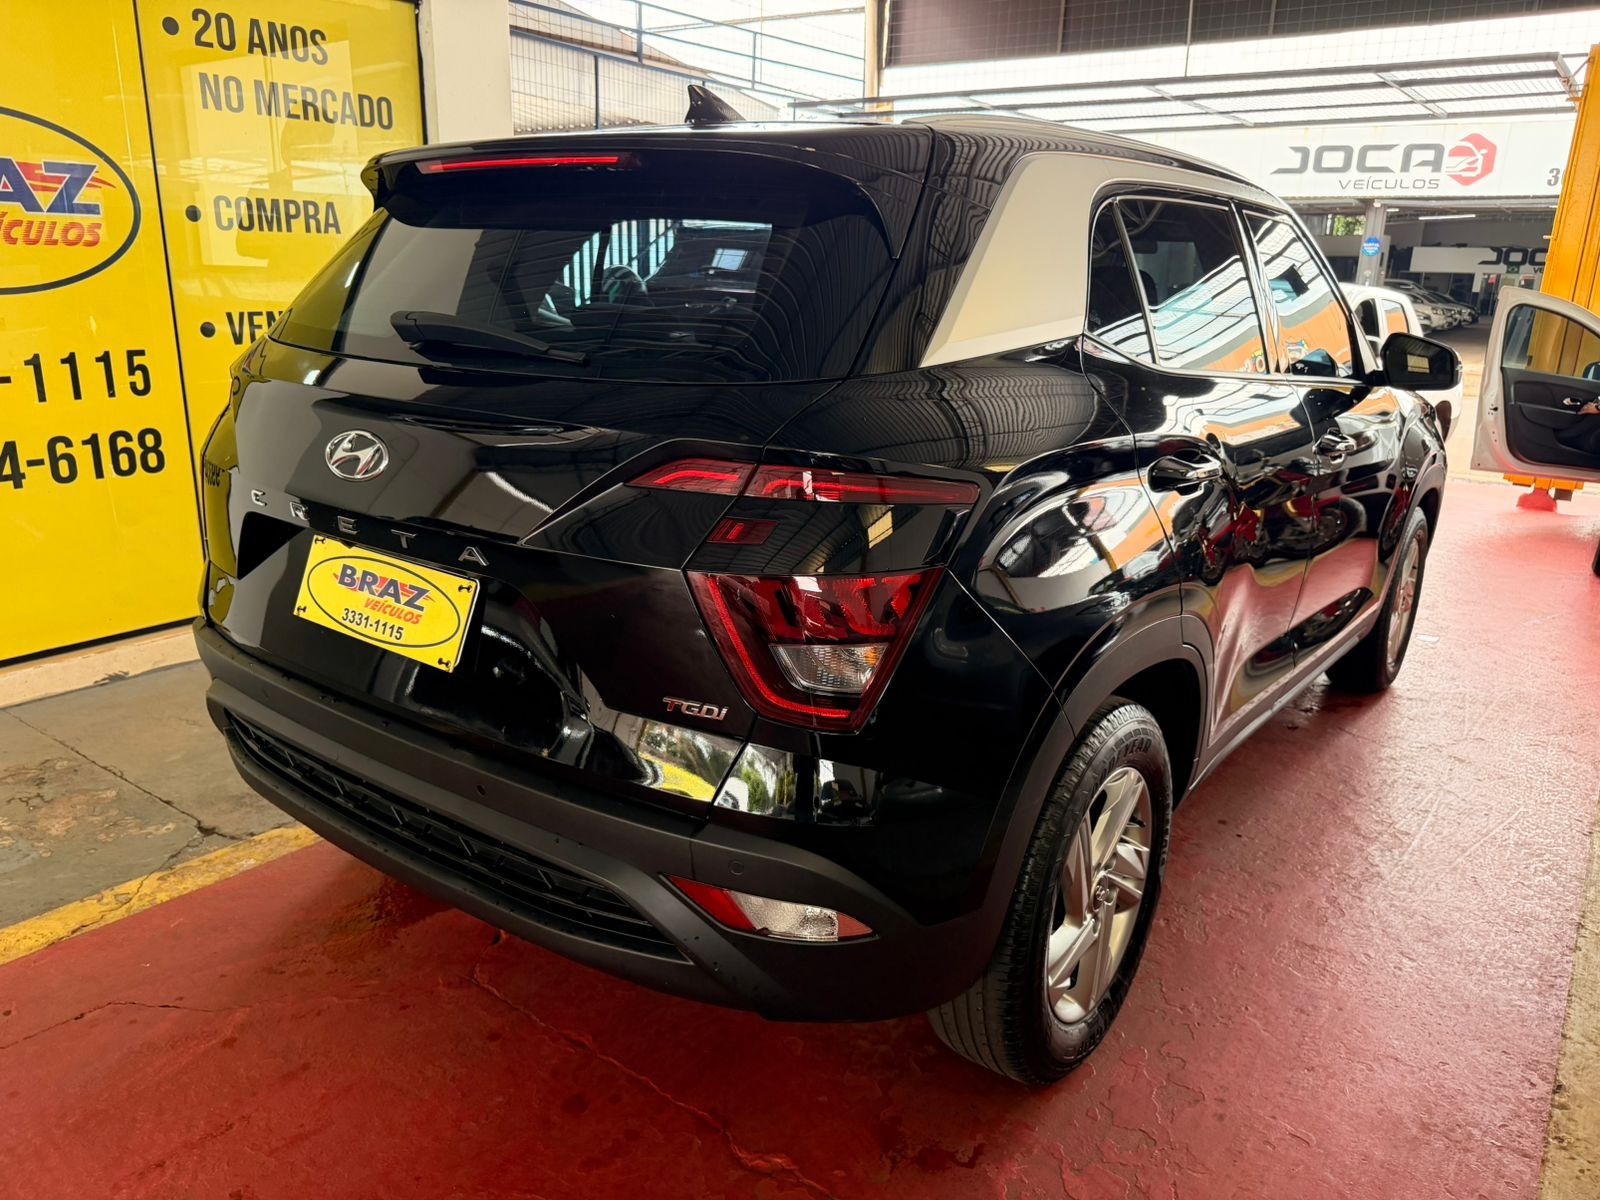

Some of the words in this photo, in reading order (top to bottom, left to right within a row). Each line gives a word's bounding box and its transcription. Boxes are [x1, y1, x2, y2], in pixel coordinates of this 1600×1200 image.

[191, 8, 237, 52] 20
[247, 18, 329, 66] ANOS
[198, 71, 244, 114] NO
[254, 79, 394, 131] MERCADO
[1270, 142, 1446, 175] JOCA
[1339, 175, 1440, 191] VEÍCULOS
[1546, 167, 1566, 187] 3
[0, 212, 102, 248] CULOS
[213, 194, 342, 236] COMPRA
[250, 489, 490, 567] CRETA
[338, 563, 432, 612] BRAZ
[341, 607, 404, 642] 3331-1115
[363, 597, 423, 626] VEÍCULOS
